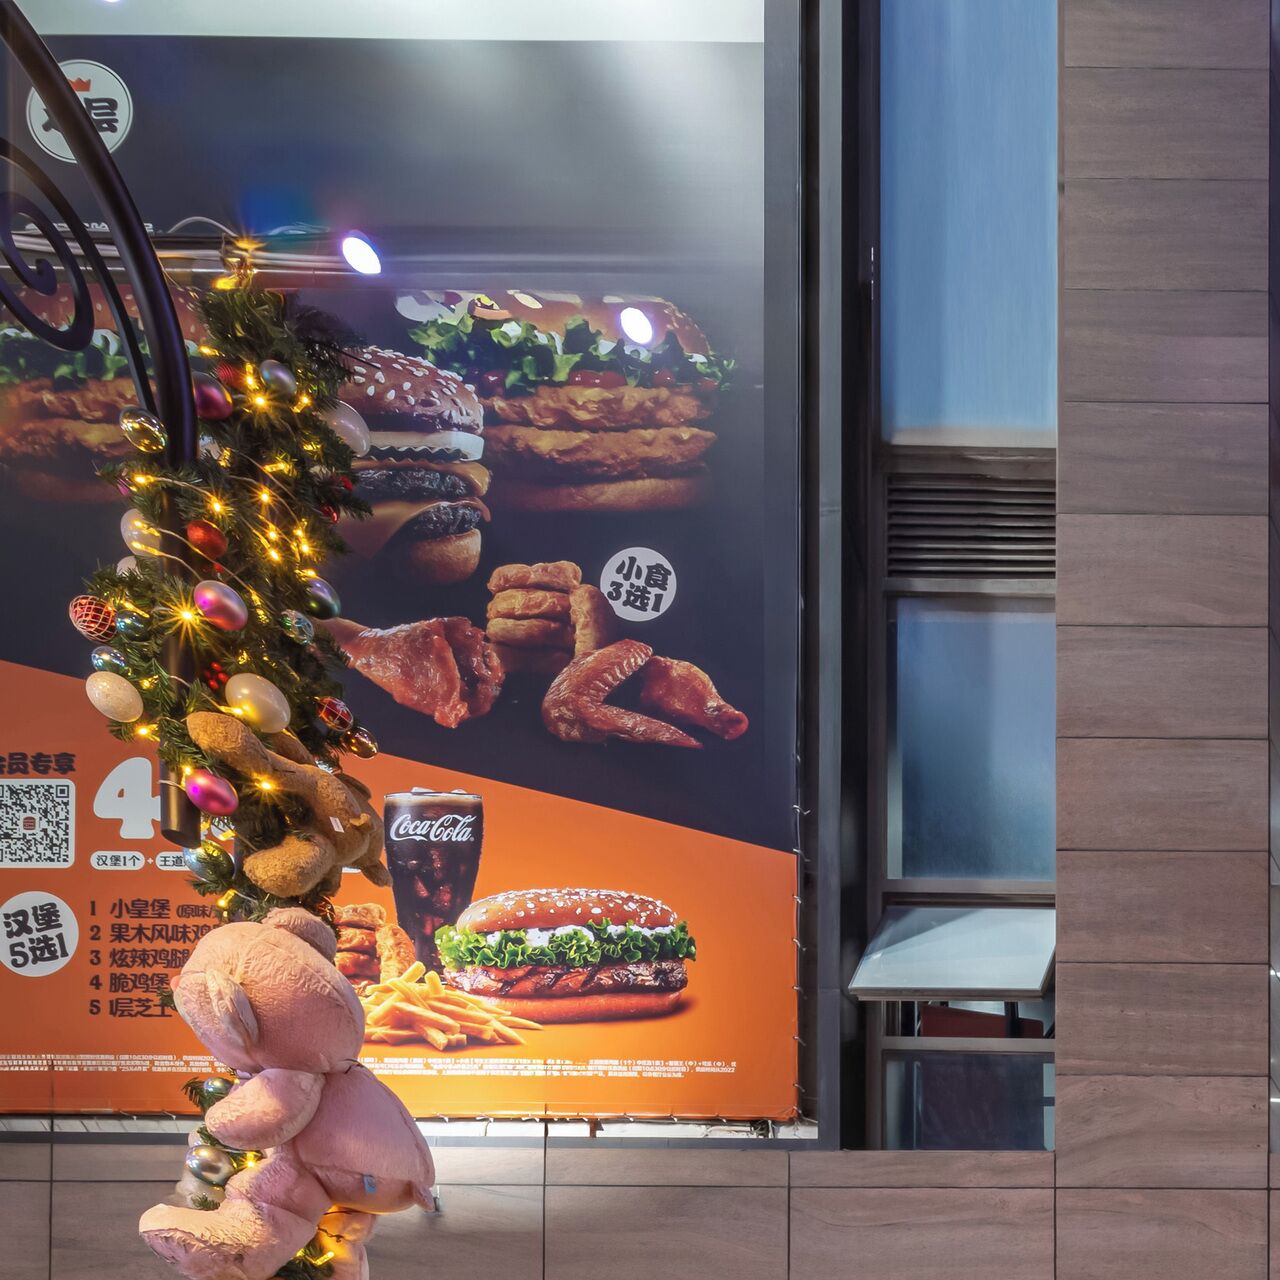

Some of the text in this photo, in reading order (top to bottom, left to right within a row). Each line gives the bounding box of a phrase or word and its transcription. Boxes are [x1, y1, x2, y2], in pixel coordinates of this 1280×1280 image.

[616, 556, 672, 591] 小食
[607, 581, 664, 613] 3选1
[0, 752, 76, 775] 员专享
[96, 855, 141, 867] 汉堡1个
[91, 901, 96, 916] 1
[110, 898, 171, 919] 小皇堡
[3, 902, 63, 939] 汉堡
[90, 925, 101, 940] 2
[10, 932, 69, 968] 5选1
[90, 950, 100, 966] 3
[89, 973, 170, 992] 4 脆鸡堡
[89, 1000, 100, 1015] 5
